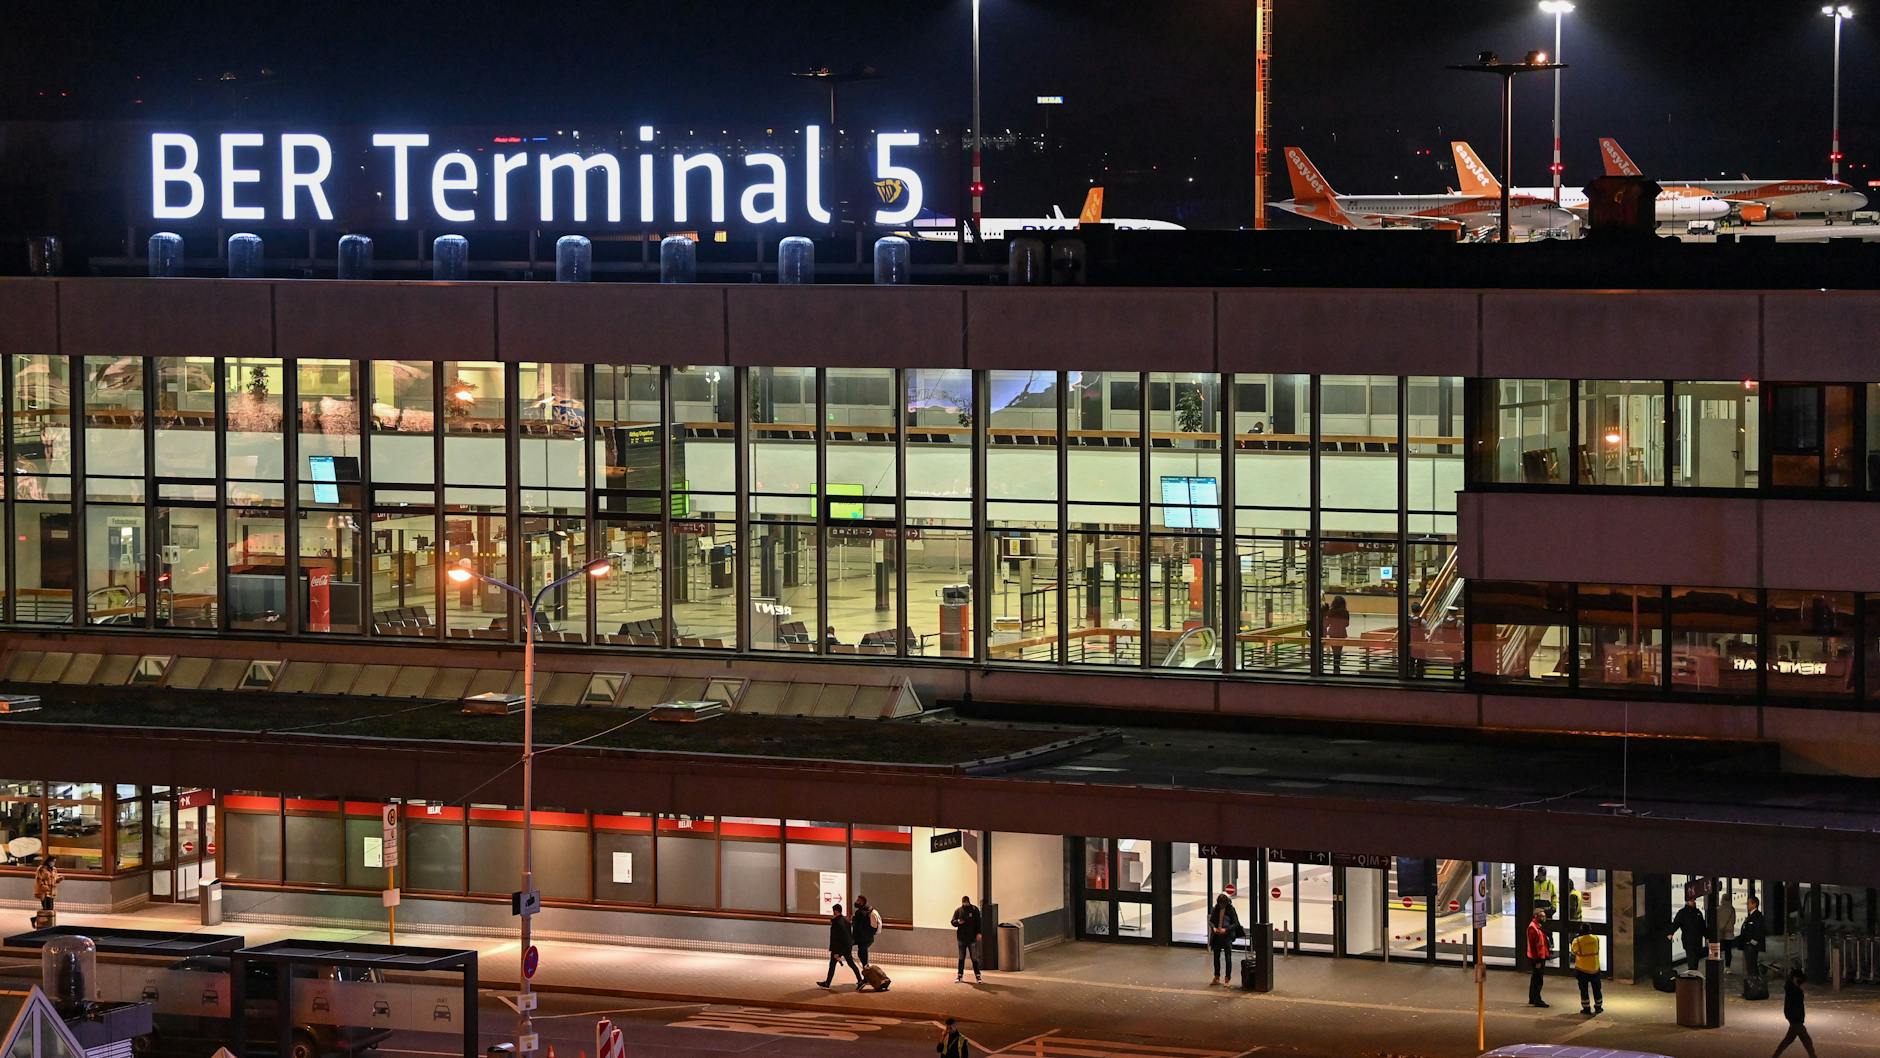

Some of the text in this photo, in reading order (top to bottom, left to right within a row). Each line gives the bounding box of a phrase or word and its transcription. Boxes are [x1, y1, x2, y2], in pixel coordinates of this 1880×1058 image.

[152, 126, 923, 224] BER Terminal 5
[1288, 151, 1323, 193] easyJet
[1456, 145, 1489, 187] easyJet
[1211, 846, 1218, 855] K
